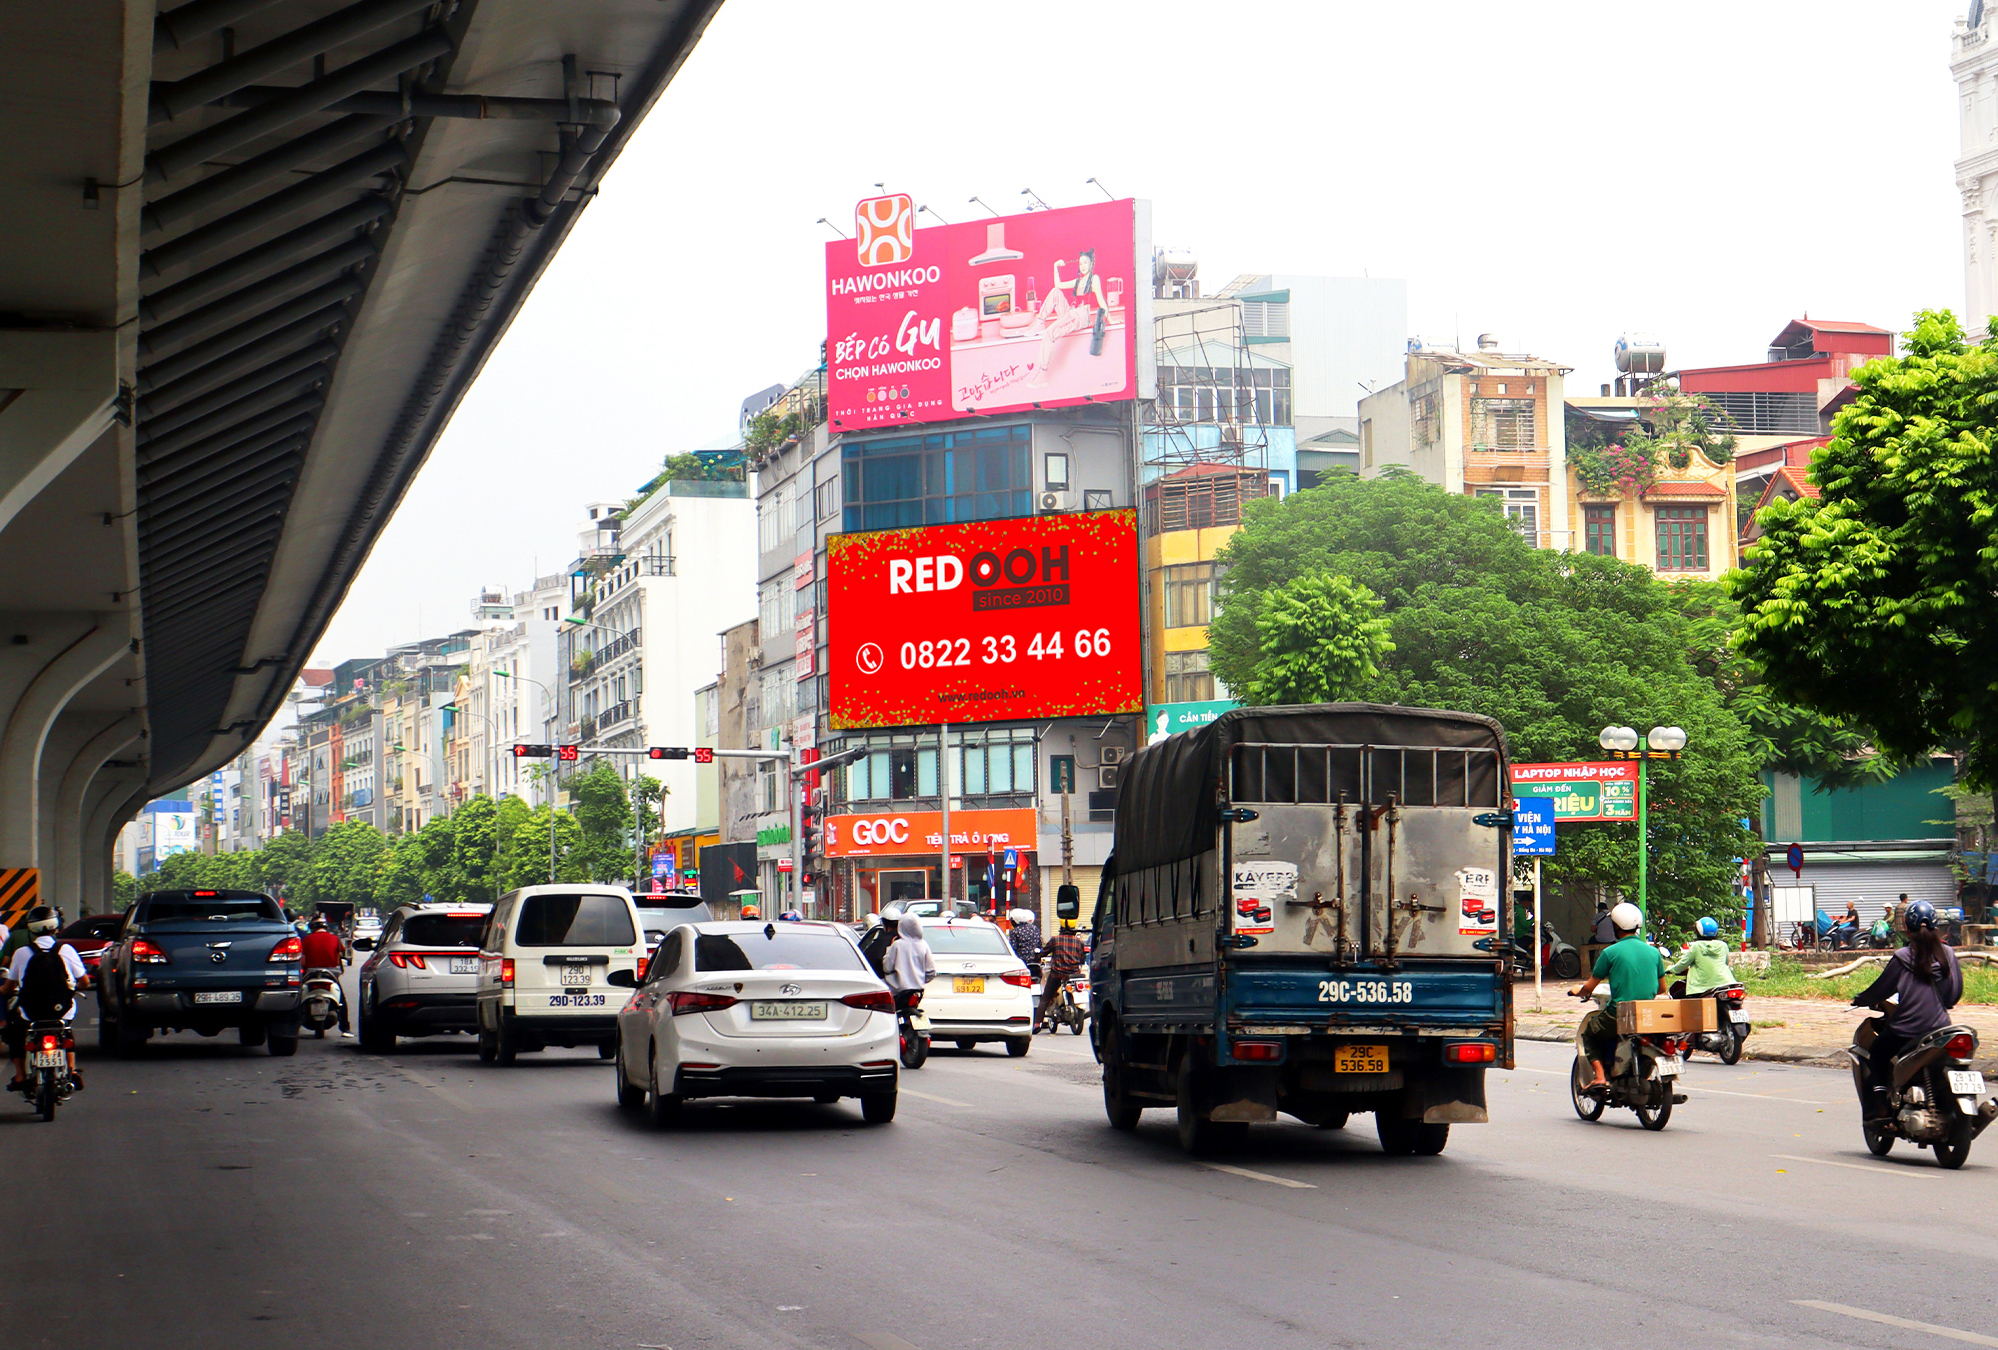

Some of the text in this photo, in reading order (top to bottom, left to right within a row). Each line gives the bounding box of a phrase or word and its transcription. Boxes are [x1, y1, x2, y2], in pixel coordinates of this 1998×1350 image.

[832, 266, 940, 296] HAWONKOO
[835, 332, 866, 364] BẾP
[835, 357, 941, 381] CHỌN HAWONKOO
[861, 404, 890, 414] TRANG
[896, 402, 912, 410] GIA
[918, 399, 943, 409] DỤNG
[890, 409, 915, 419] QUC
[979, 588, 1063, 608] since 2010
[899, 628, 1111, 670] 0822 33 44 66
[938, 688, 1026, 704] www.redooh.vn
[560, 746, 577, 761] 55
[695, 748, 713, 763] 55
[1514, 766, 1626, 779] LAPTOP NHẬP HỌC
[1532, 783, 1572, 793] GIẢM ĐẾN
[1554, 792, 1595, 816] RIỆU
[853, 818, 909, 845] GOC
[1522, 823, 1535, 834] HÀ
[1536, 824, 1552, 836] NỘI
[972, 831, 981, 844] Ô
[568, 965, 584, 975] 29D
[563, 975, 591, 985] 123.39
[1317, 981, 1413, 1003] 29C-536.58
[549, 995, 606, 1007] 29D-123.39
[758, 1005, 821, 1017] 34A-412.25
[1350, 1046, 1374, 1058] 29C
[1340, 1059, 1384, 1072] 536.58
